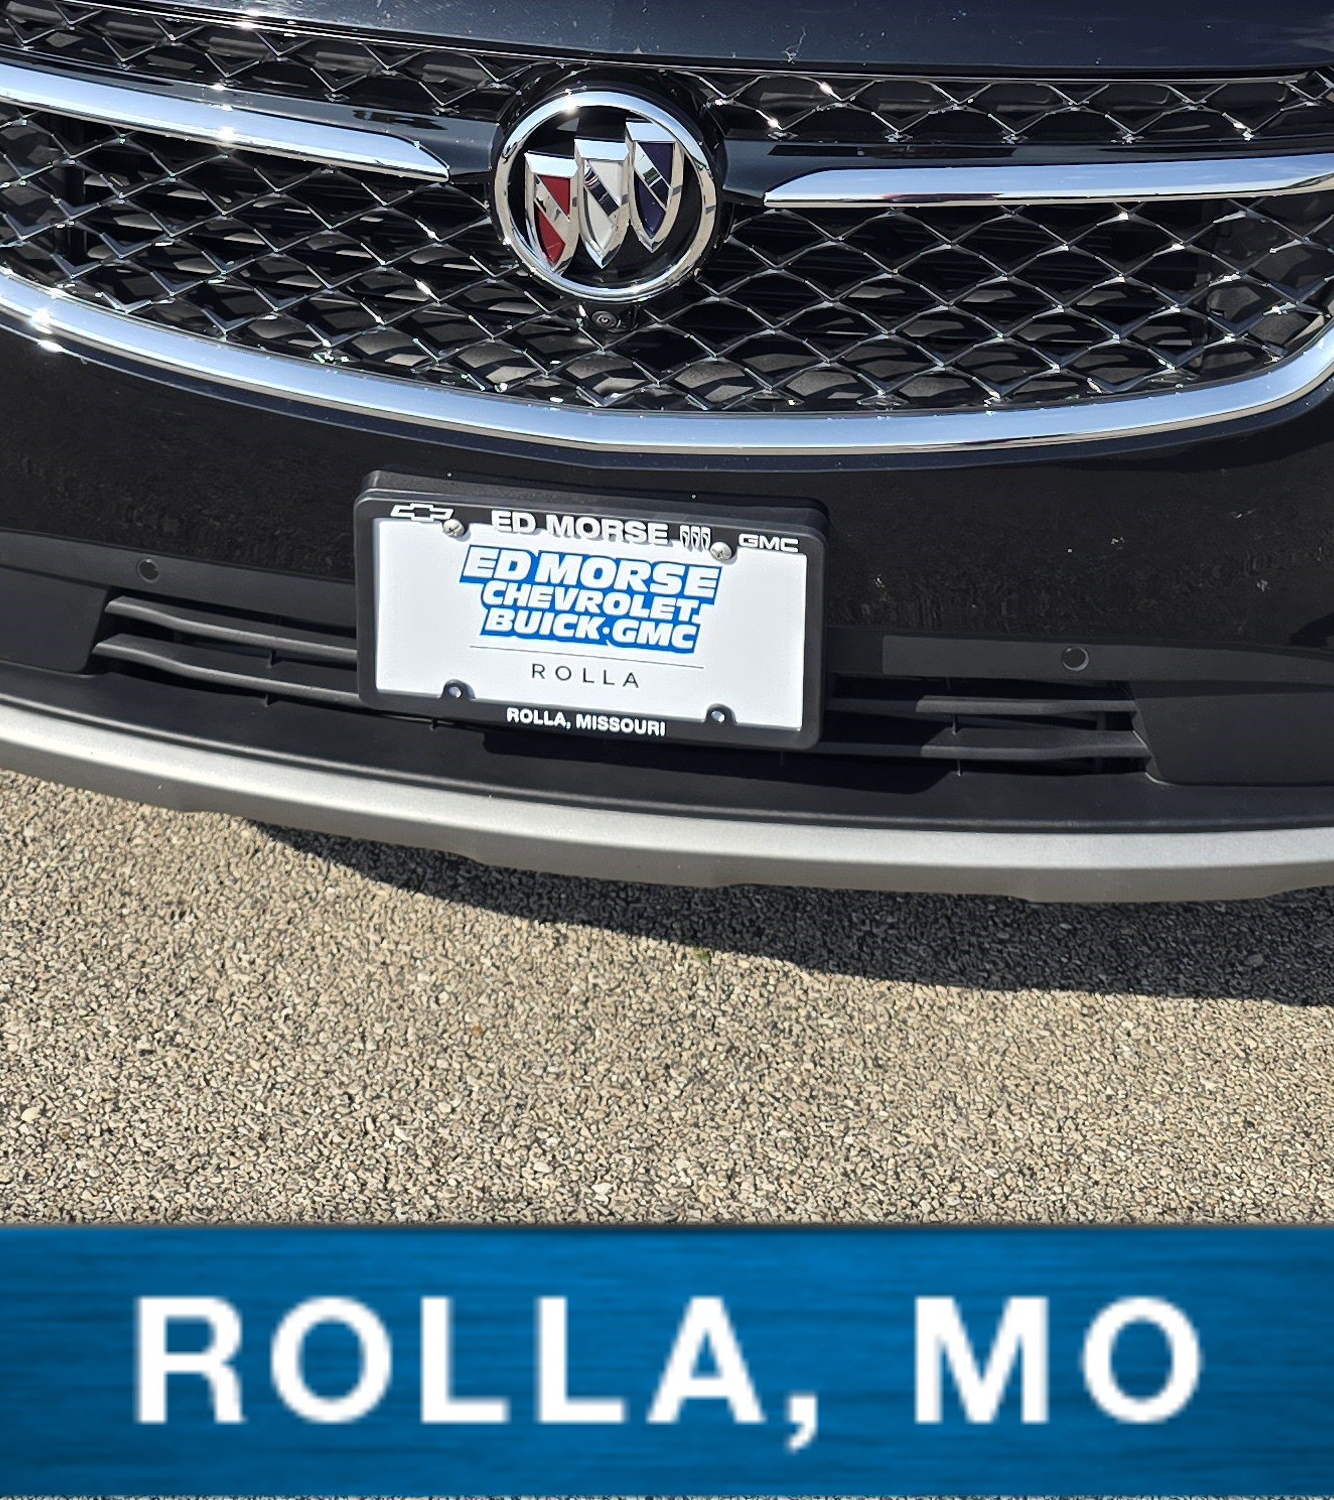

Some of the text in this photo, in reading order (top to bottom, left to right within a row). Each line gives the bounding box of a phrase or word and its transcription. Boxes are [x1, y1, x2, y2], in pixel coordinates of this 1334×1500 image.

[491, 510, 799, 553] ED MORSE GMC
[462, 546, 721, 600] ED MORSE
[531, 662, 640, 689] ROLLA
[506, 706, 666, 737] ROLLA, MISSOURI
